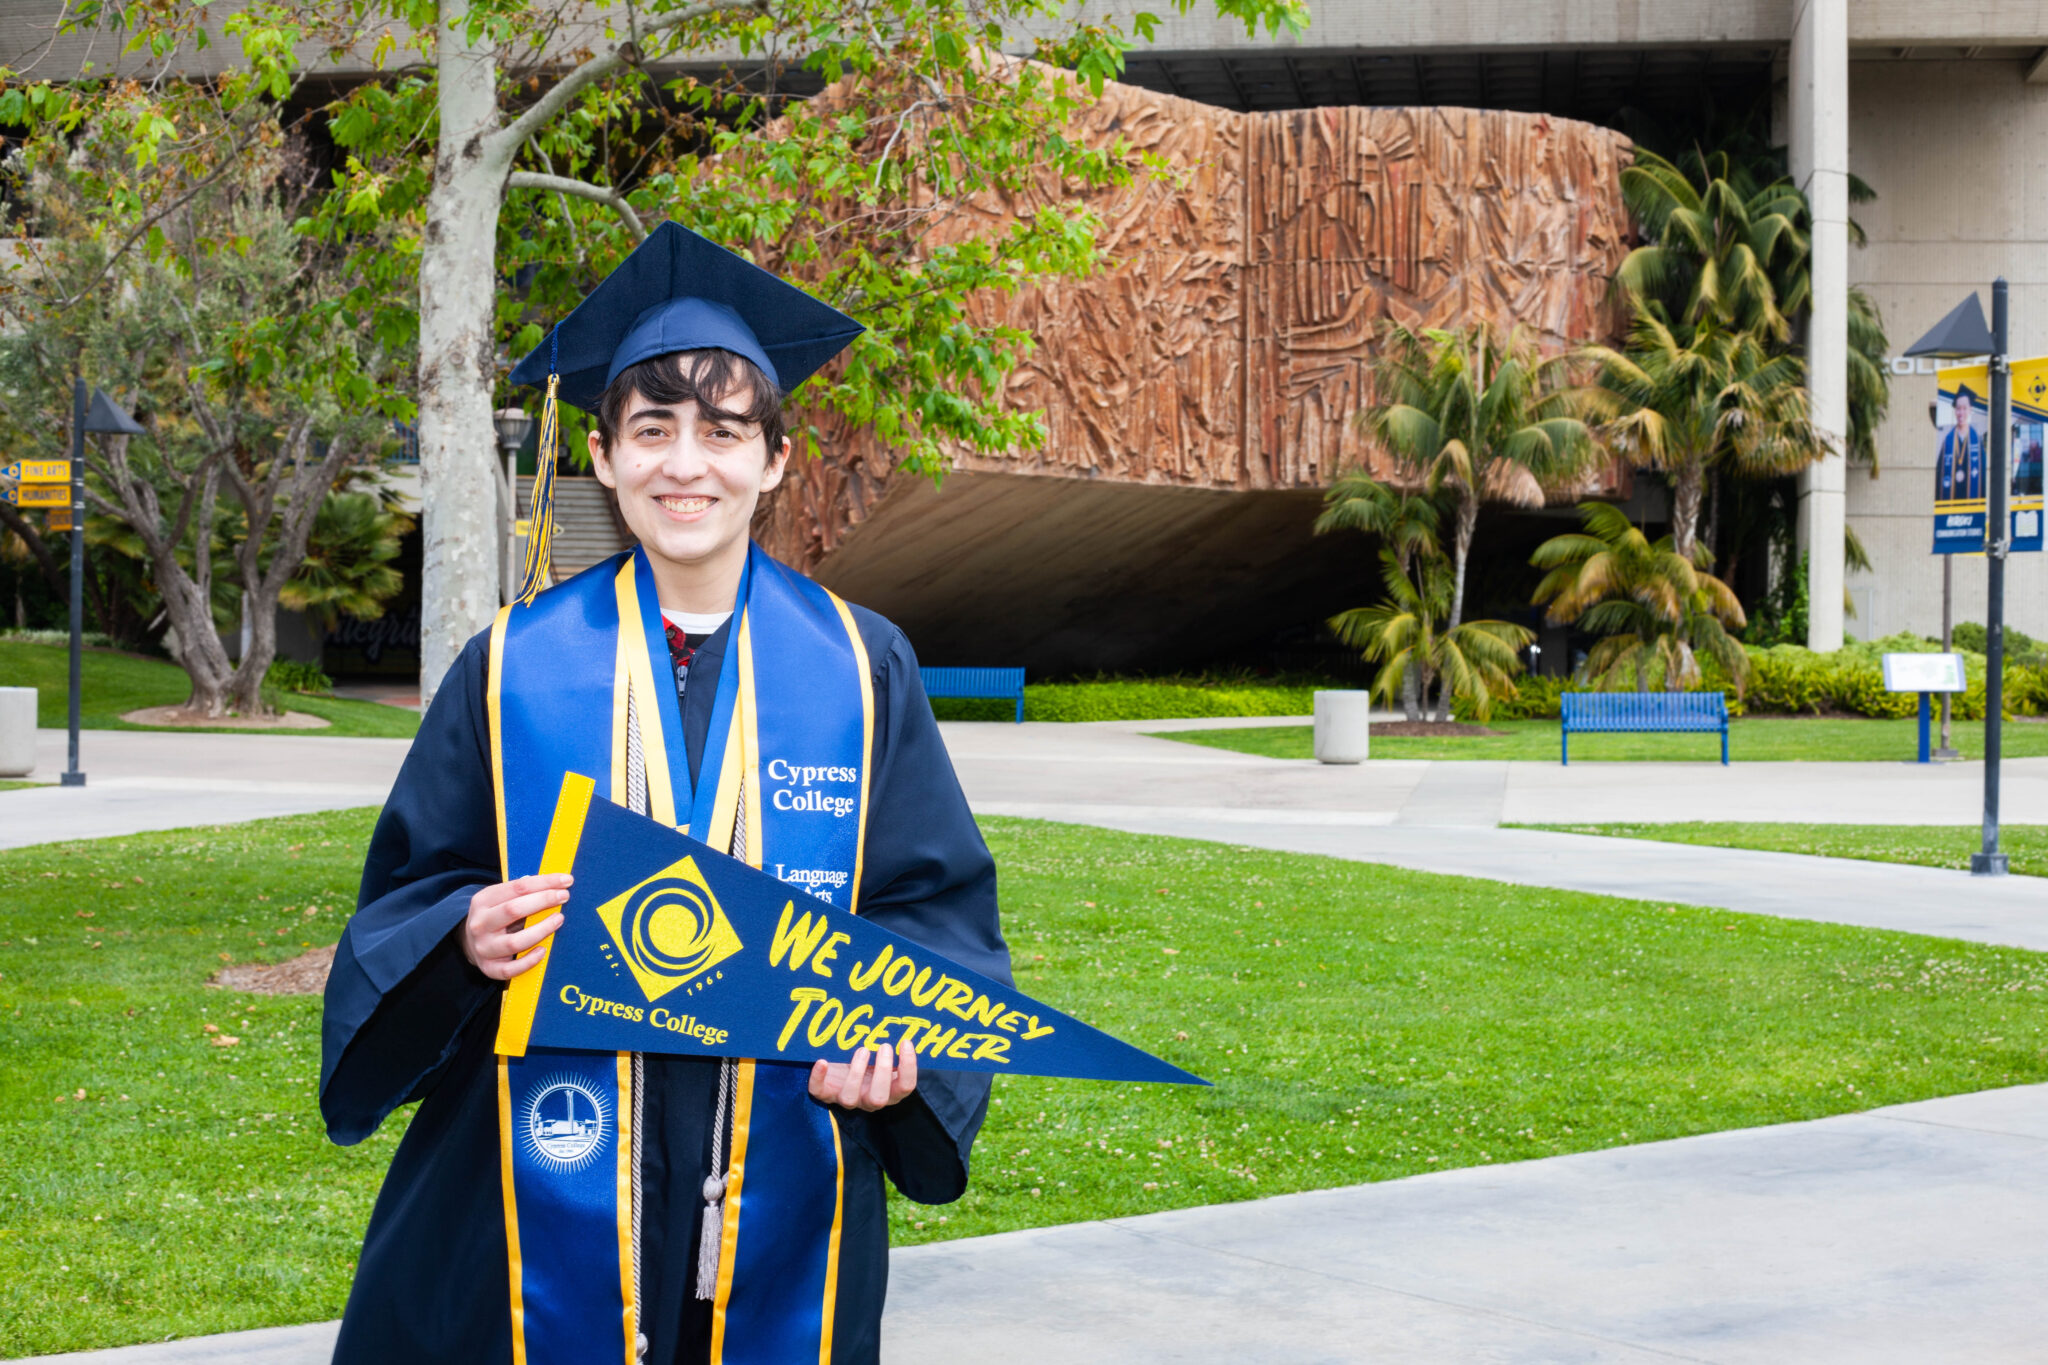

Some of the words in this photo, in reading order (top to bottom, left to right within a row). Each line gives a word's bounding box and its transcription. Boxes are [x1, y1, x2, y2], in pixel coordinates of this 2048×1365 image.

[25, 464, 44, 477] FINE
[46, 464, 66, 477] ARTS
[22, 488, 67, 501] HUMANITIES
[768, 759, 857, 787] Cypress
[773, 789, 854, 818] College
[775, 863, 848, 889] Language
[599, 943, 620, 977] Est.
[686, 970, 724, 997] 1966
[769, 899, 851, 978] WE
[848, 944, 1055, 1041] JOURNEY
[559, 984, 645, 1022] Cypress
[649, 1008, 729, 1046] College
[777, 987, 1012, 1064] TOGETHER
